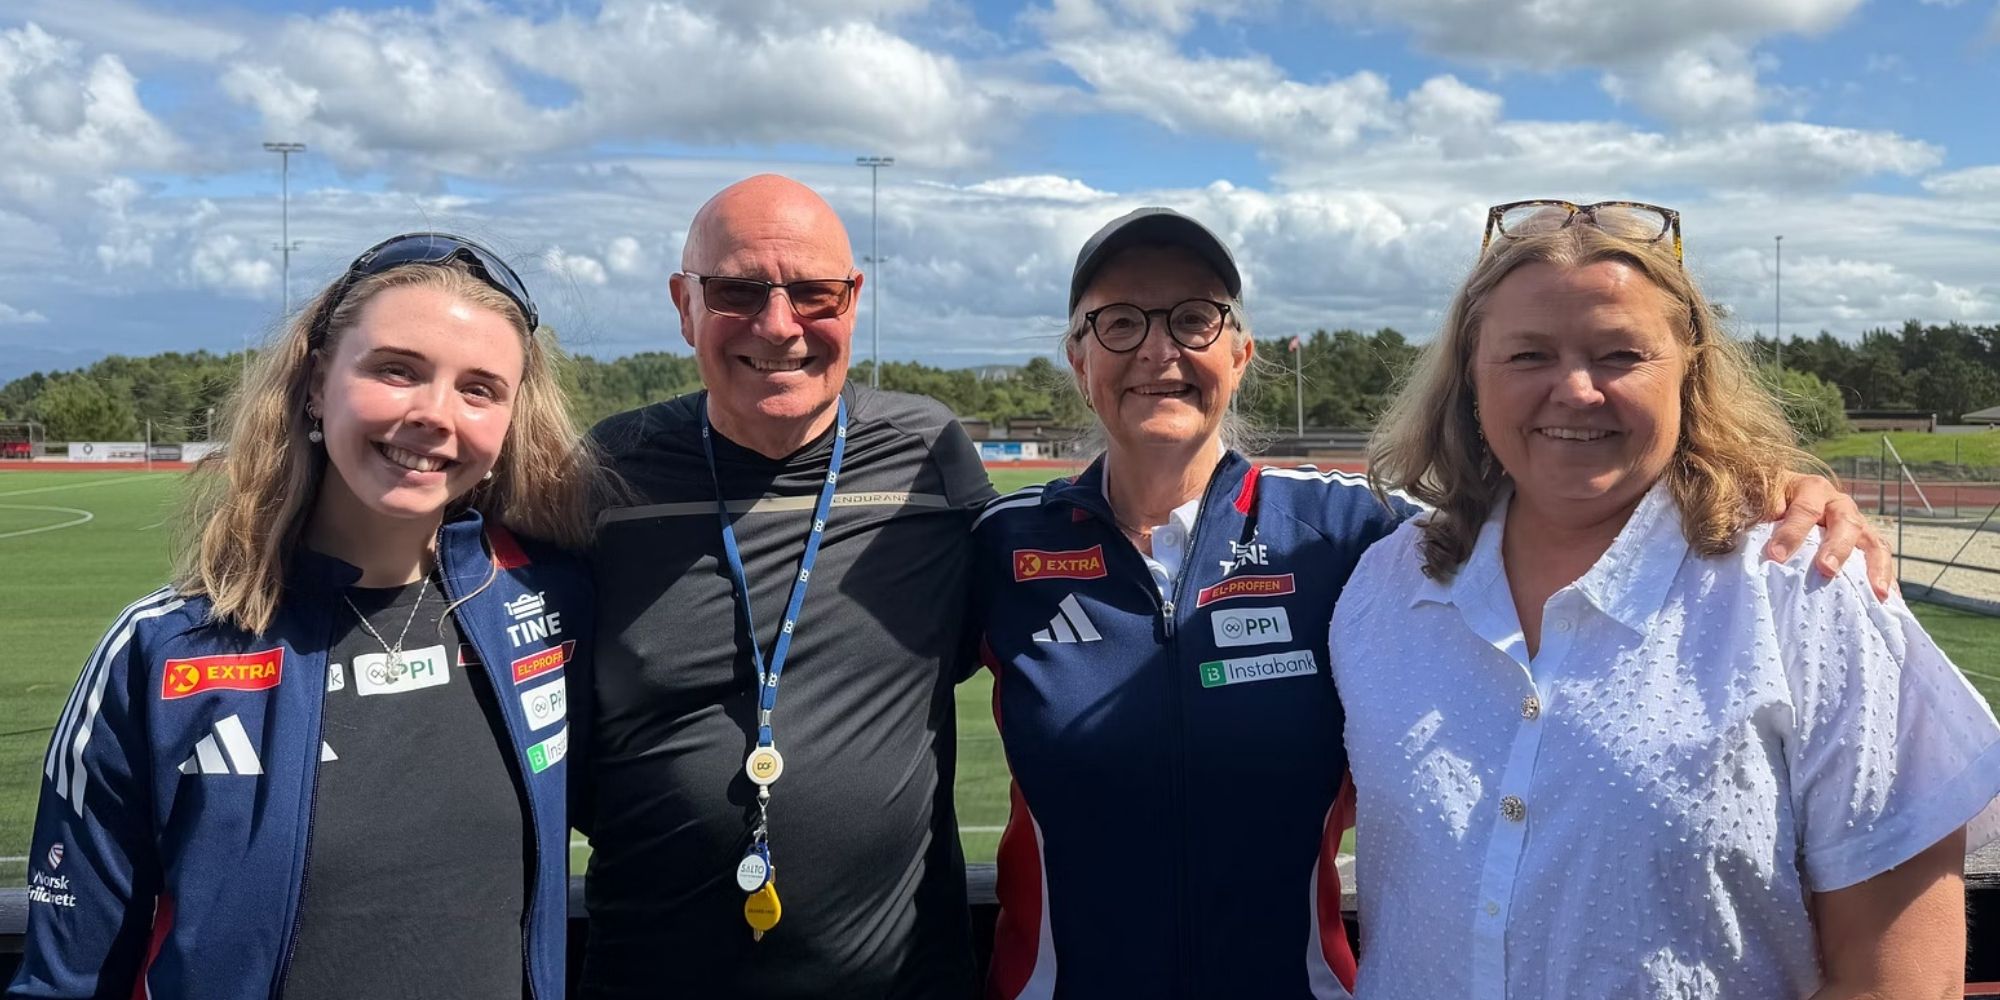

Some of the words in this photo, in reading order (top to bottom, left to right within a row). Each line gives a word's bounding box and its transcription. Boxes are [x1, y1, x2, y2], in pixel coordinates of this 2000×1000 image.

[834, 494, 916, 504] ENDURANCE
[1046, 556, 1100, 572] EXTRA
[1211, 580, 1281, 599] EL-PROFFEN
[506, 611, 562, 648] TINE
[1245, 616, 1280, 636] PPI
[207, 661, 276, 680] EXTRA
[1228, 653, 1317, 680] Instabank
[740, 863, 765, 875] SALTO
[33, 869, 70, 890] Norsk
